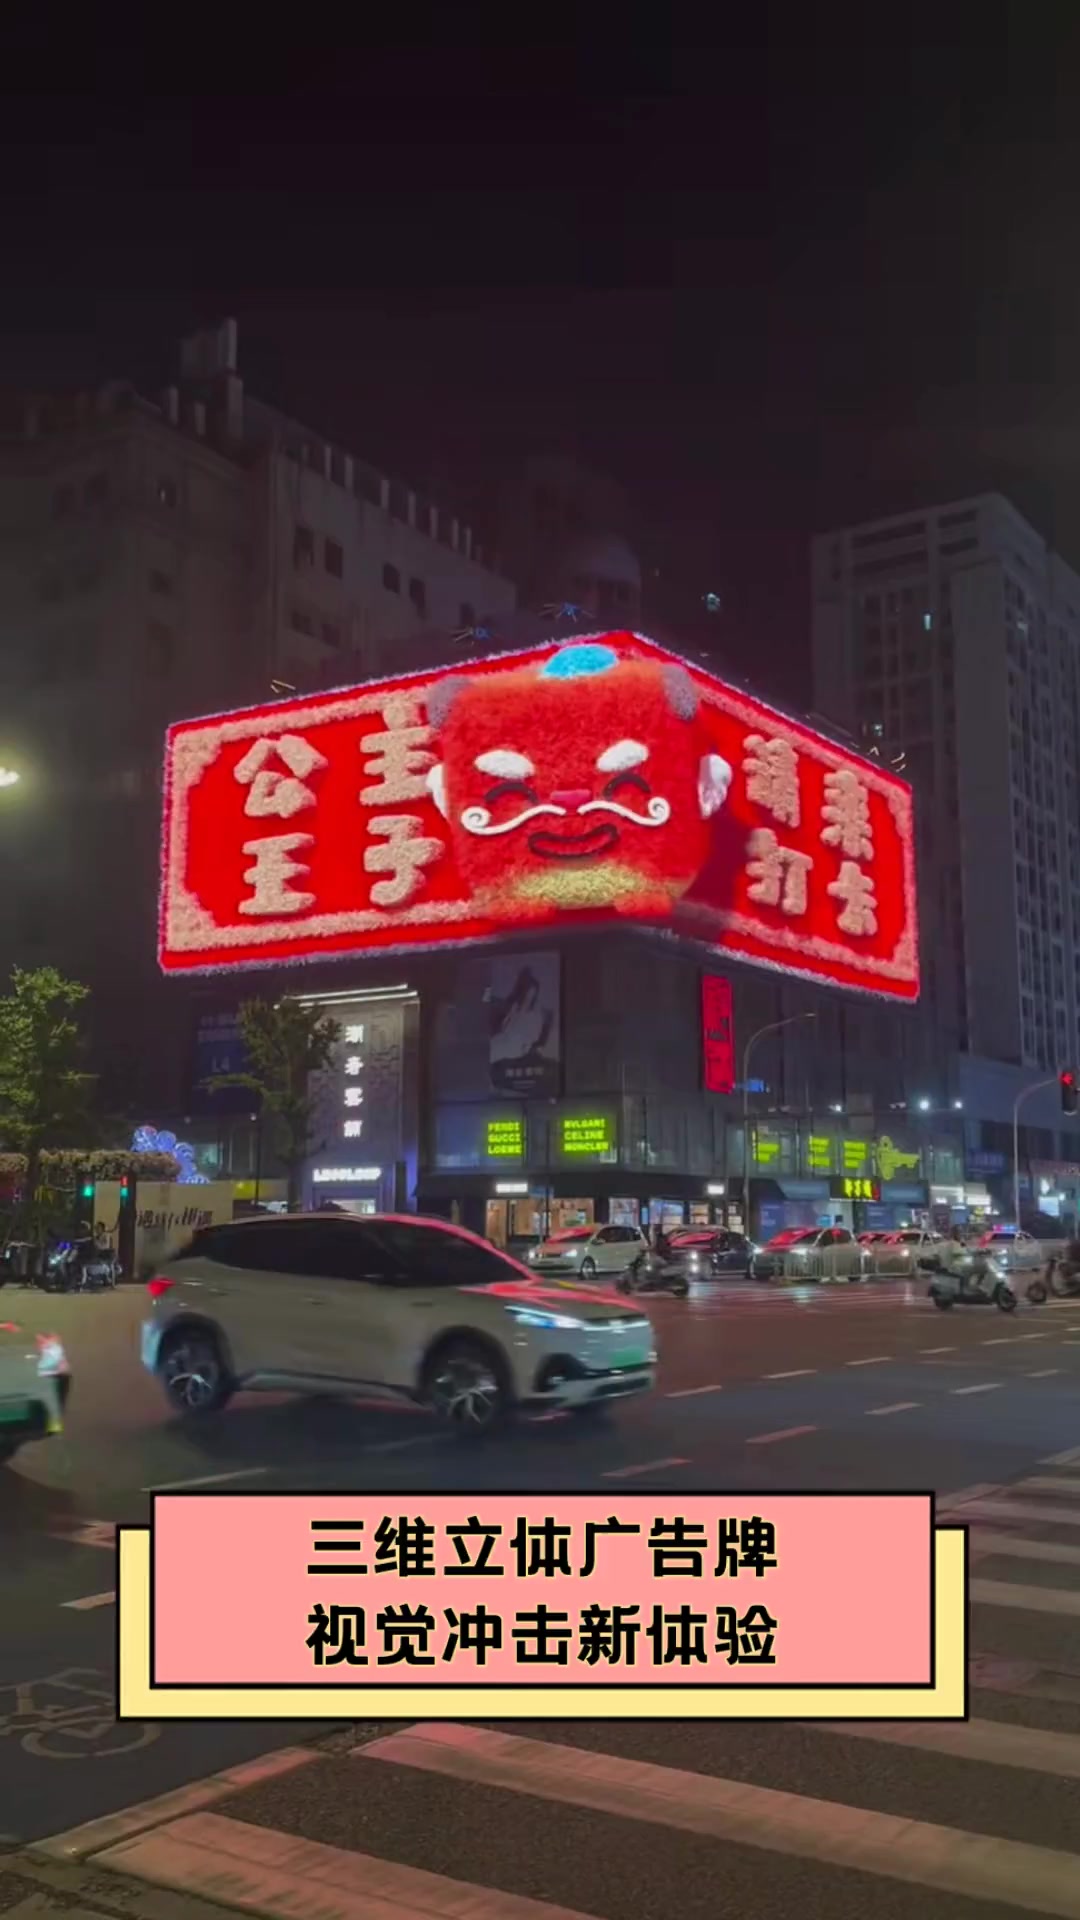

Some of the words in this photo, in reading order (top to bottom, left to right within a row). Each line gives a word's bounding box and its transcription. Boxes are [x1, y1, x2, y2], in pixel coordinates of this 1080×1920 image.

[488, 1122, 520, 1132] FENDI
[488, 1133, 521, 1143] GUCCI
[564, 1130, 604, 1140] CELINE
[488, 1144, 522, 1154] LOEWE
[564, 1141, 608, 1151] MONCLER
